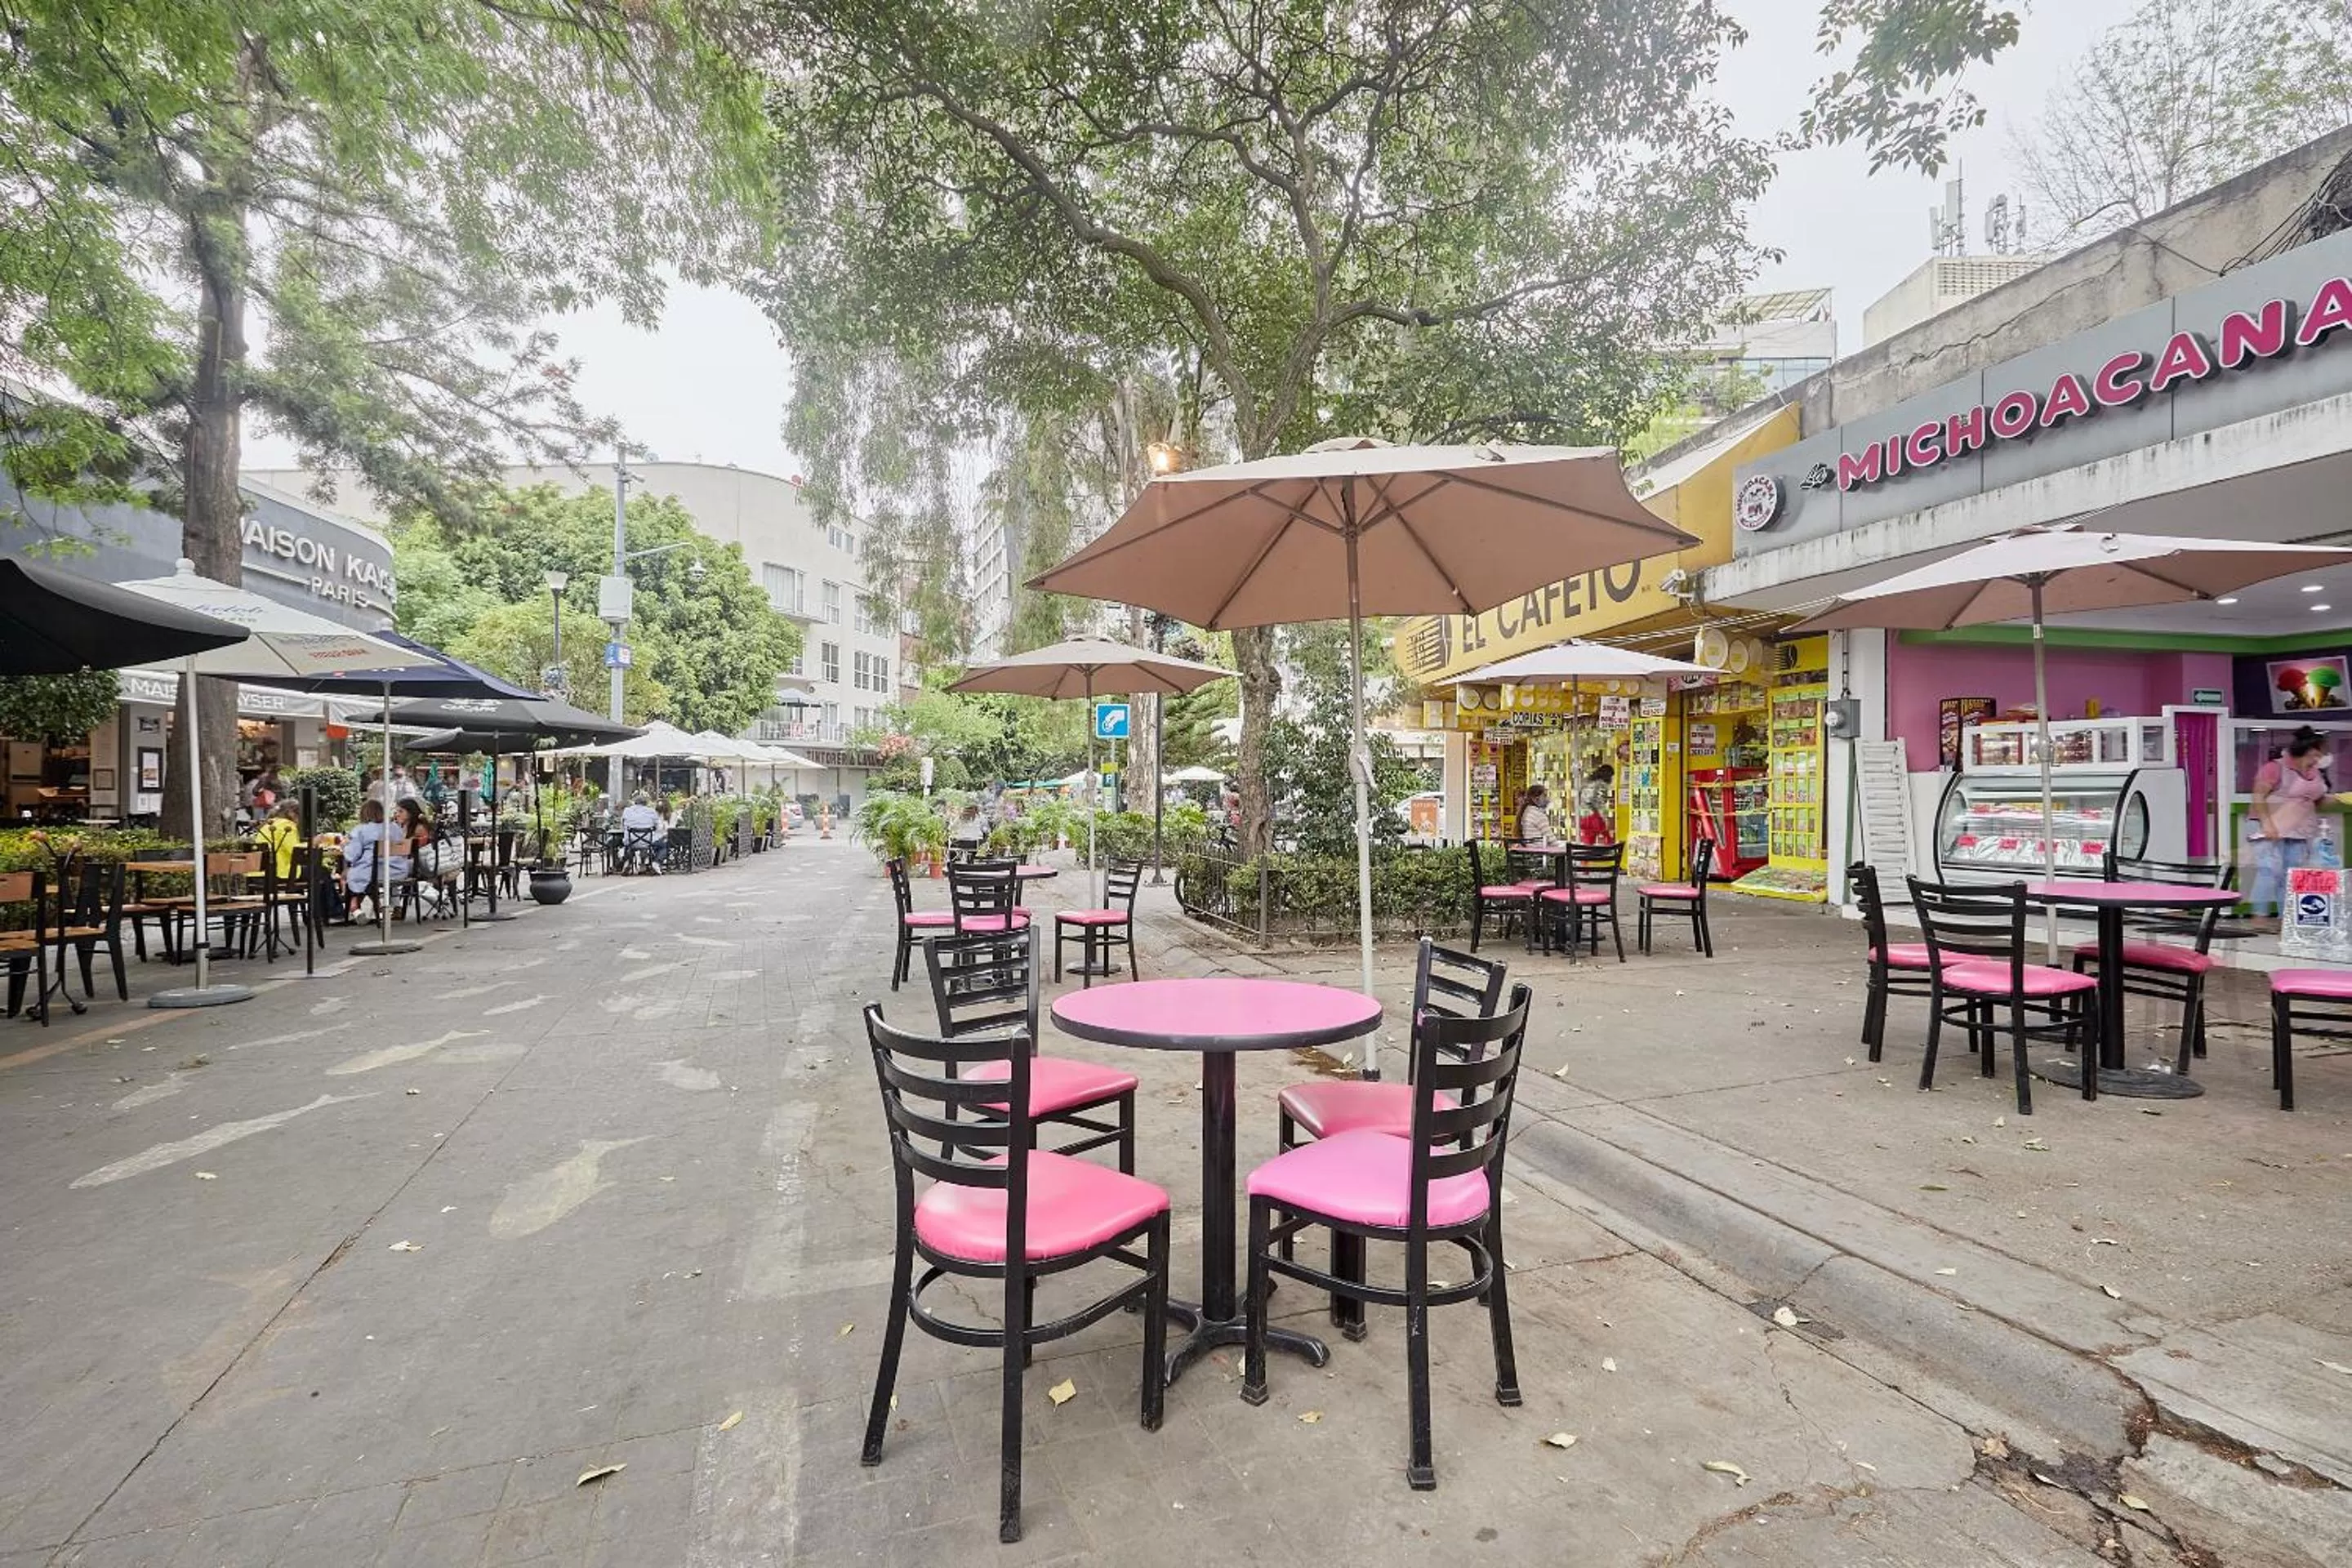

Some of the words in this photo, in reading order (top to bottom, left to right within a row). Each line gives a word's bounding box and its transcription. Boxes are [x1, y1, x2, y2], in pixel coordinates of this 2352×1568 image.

[1837, 277, 2352, 492] MICHOACANA
[240, 516, 335, 572] AISON
[311, 576, 369, 608] PARIS
